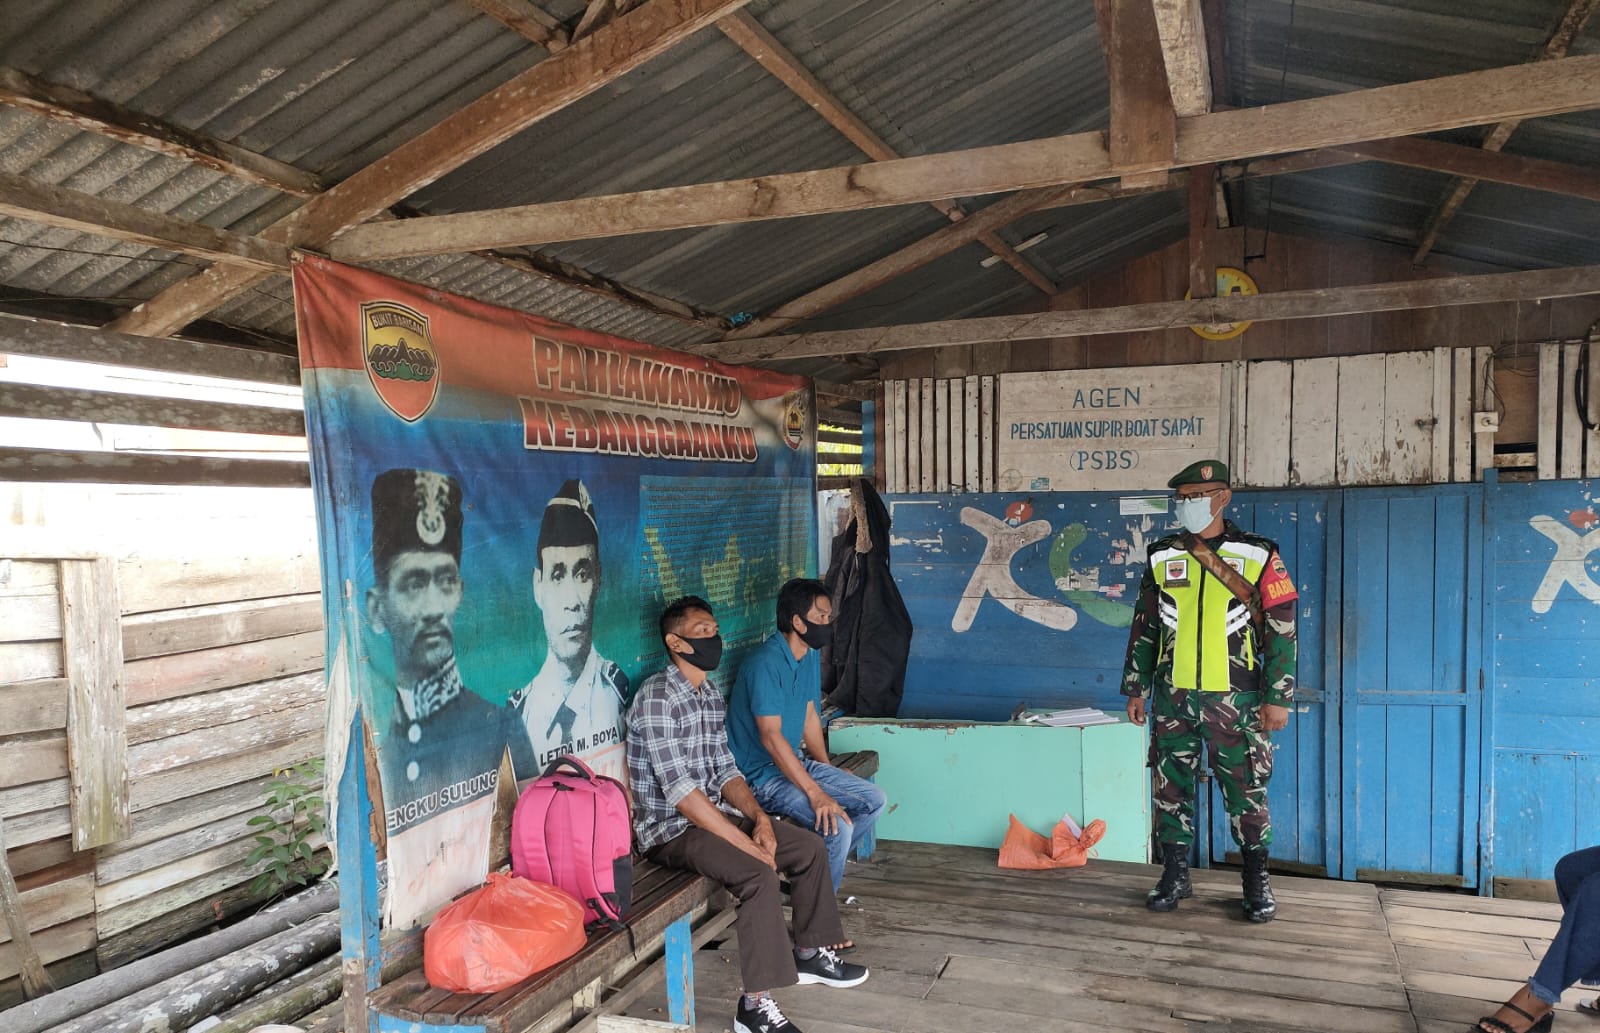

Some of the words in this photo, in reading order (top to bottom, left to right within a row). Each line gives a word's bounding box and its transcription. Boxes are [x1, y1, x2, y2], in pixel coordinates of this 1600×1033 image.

[371, 312, 392, 328] BUKIT
[532, 335, 742, 417] PAHLAWANKU
[1072, 387, 1141, 409] AGEN
[519, 397, 758, 463] KEBANGGAANKU
[1010, 420, 1082, 440] PERSATUAN
[1085, 420, 1123, 438] SUPIR
[1125, 418, 1159, 438] BOAT
[1161, 416, 1204, 437] SAPAT
[540, 740, 574, 767] LETDA
[577, 736, 589, 753] M.
[592, 726, 618, 747] BOYA
[440, 769, 499, 806] SULUNG
